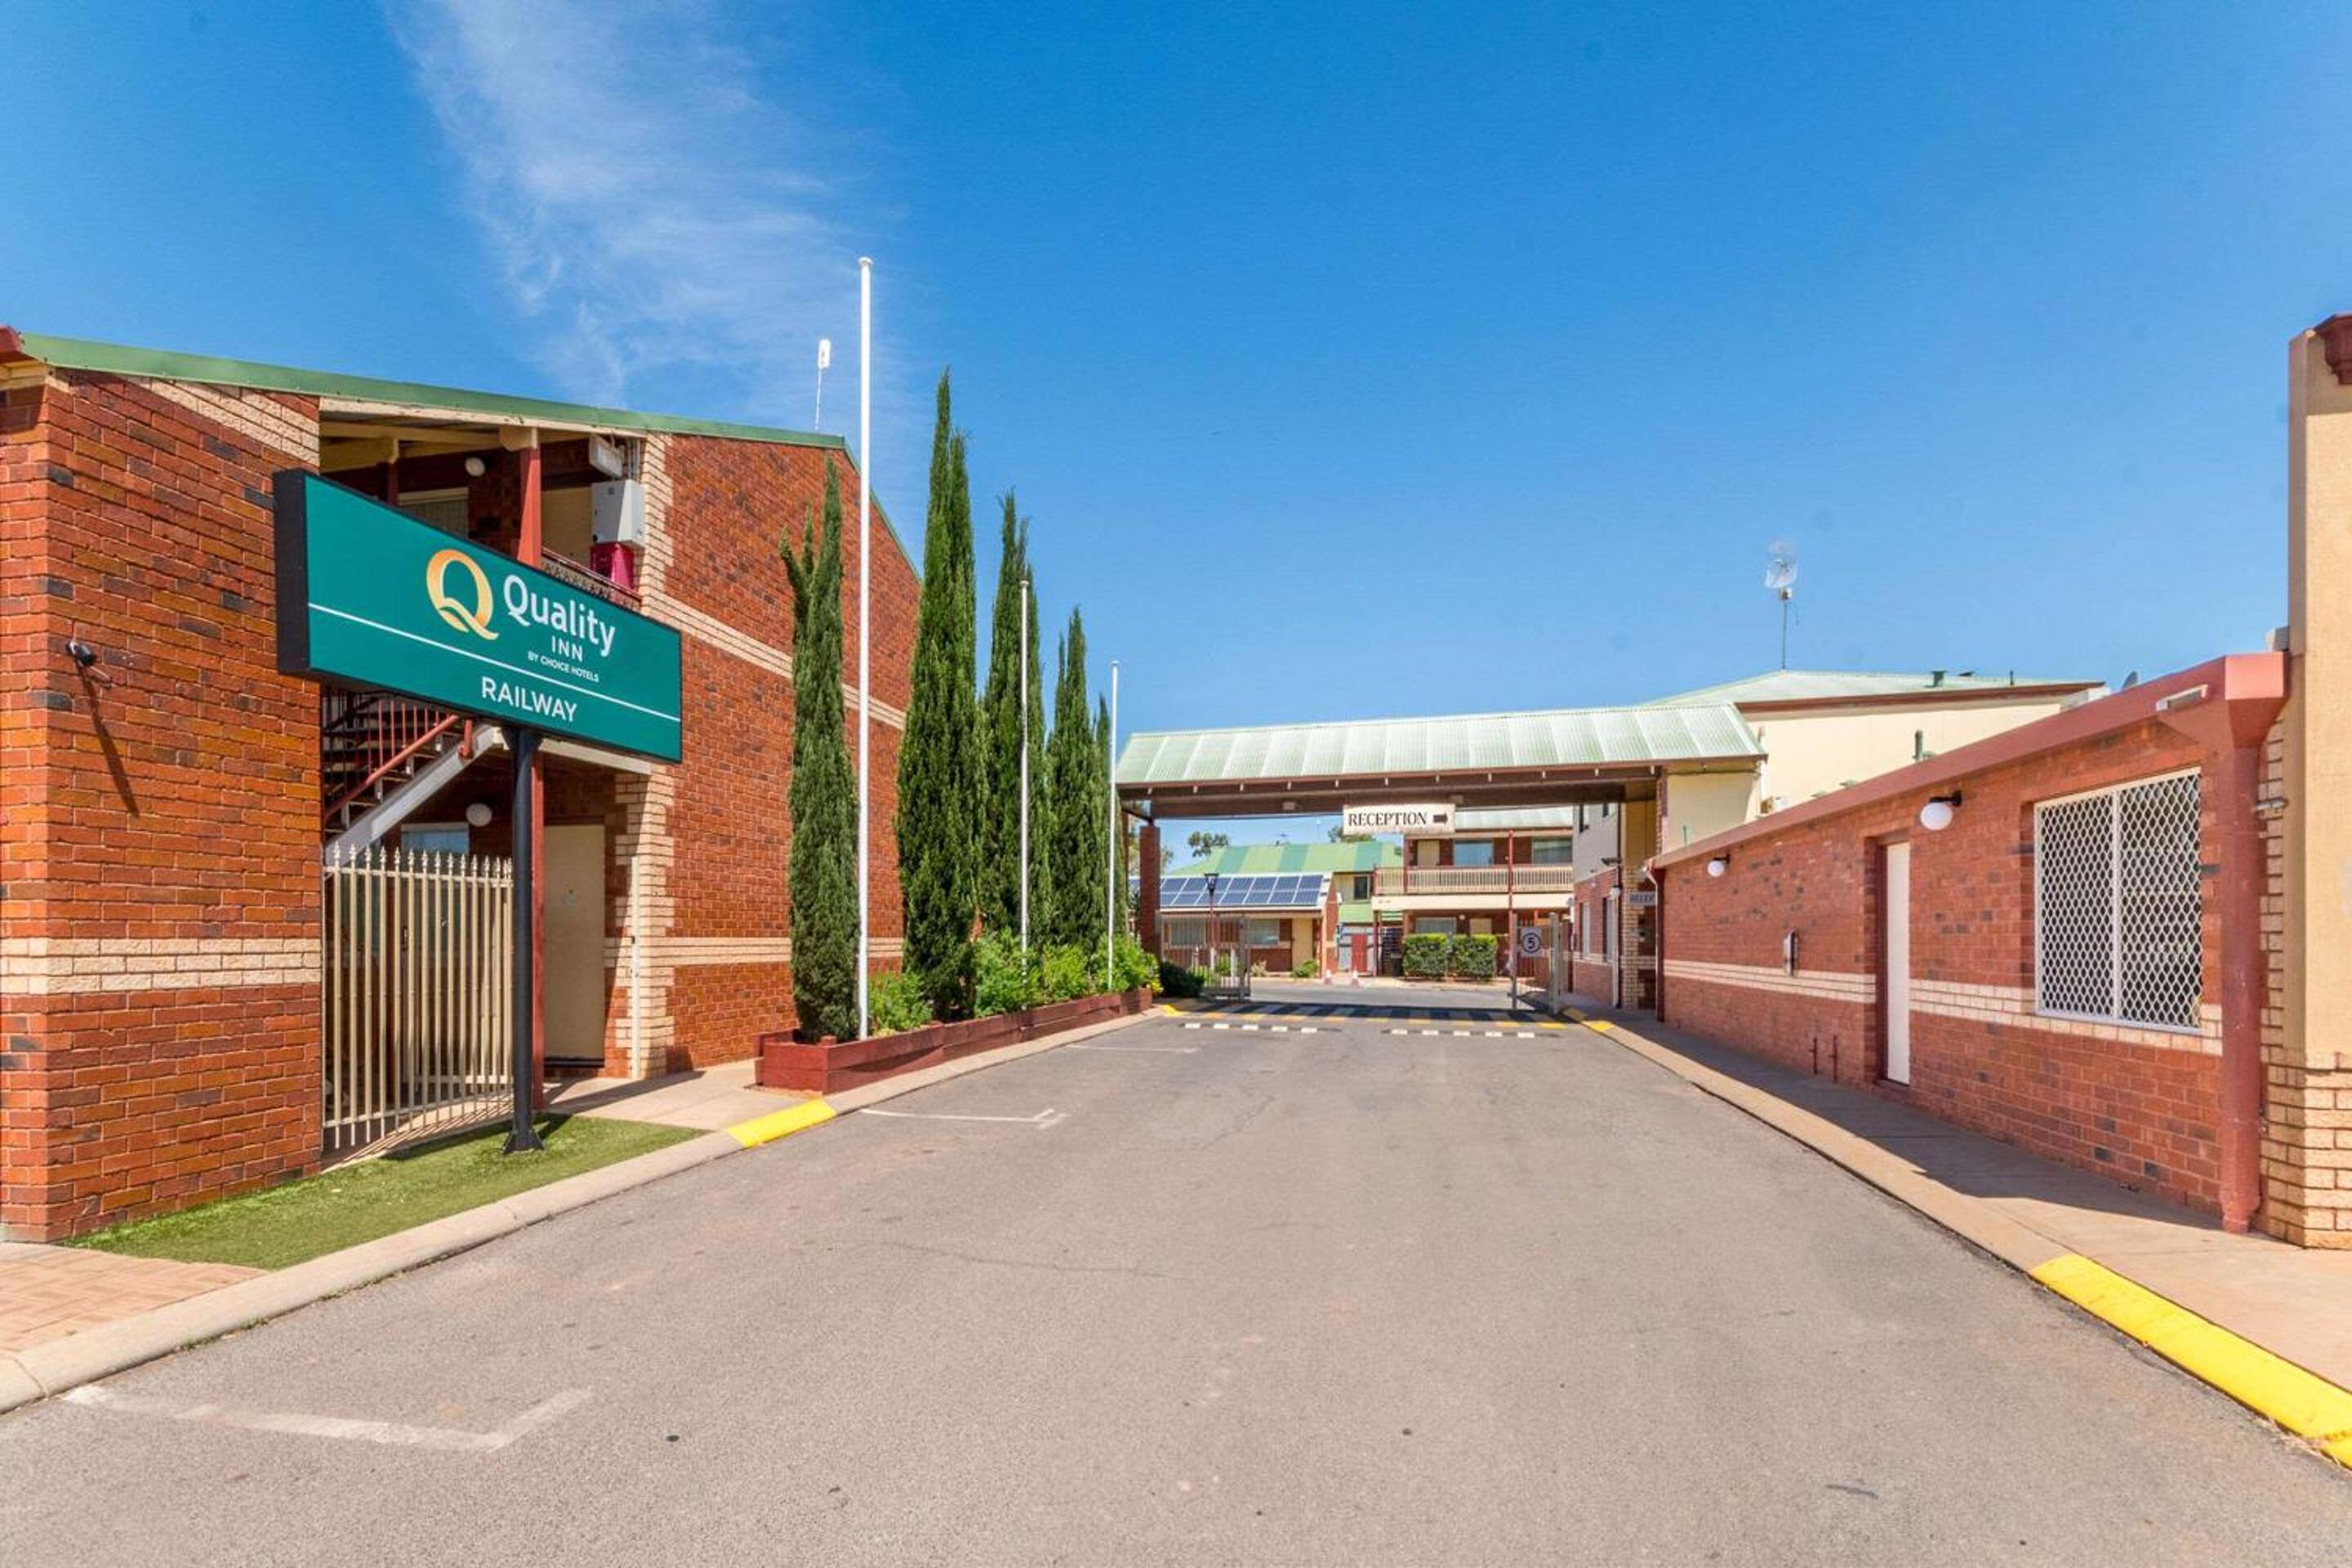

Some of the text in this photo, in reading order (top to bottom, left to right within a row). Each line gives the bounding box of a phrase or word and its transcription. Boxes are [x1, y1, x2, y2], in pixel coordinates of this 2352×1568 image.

[426, 549, 500, 640] Q
[503, 574, 616, 657] Quality
[551, 635, 583, 662] INN
[527, 650, 599, 683] BY CHOICE HOTELS
[482, 676, 577, 723] RAILWAY
[1348, 811, 1428, 827] RECEPTION
[1528, 937, 1536, 949] 5
